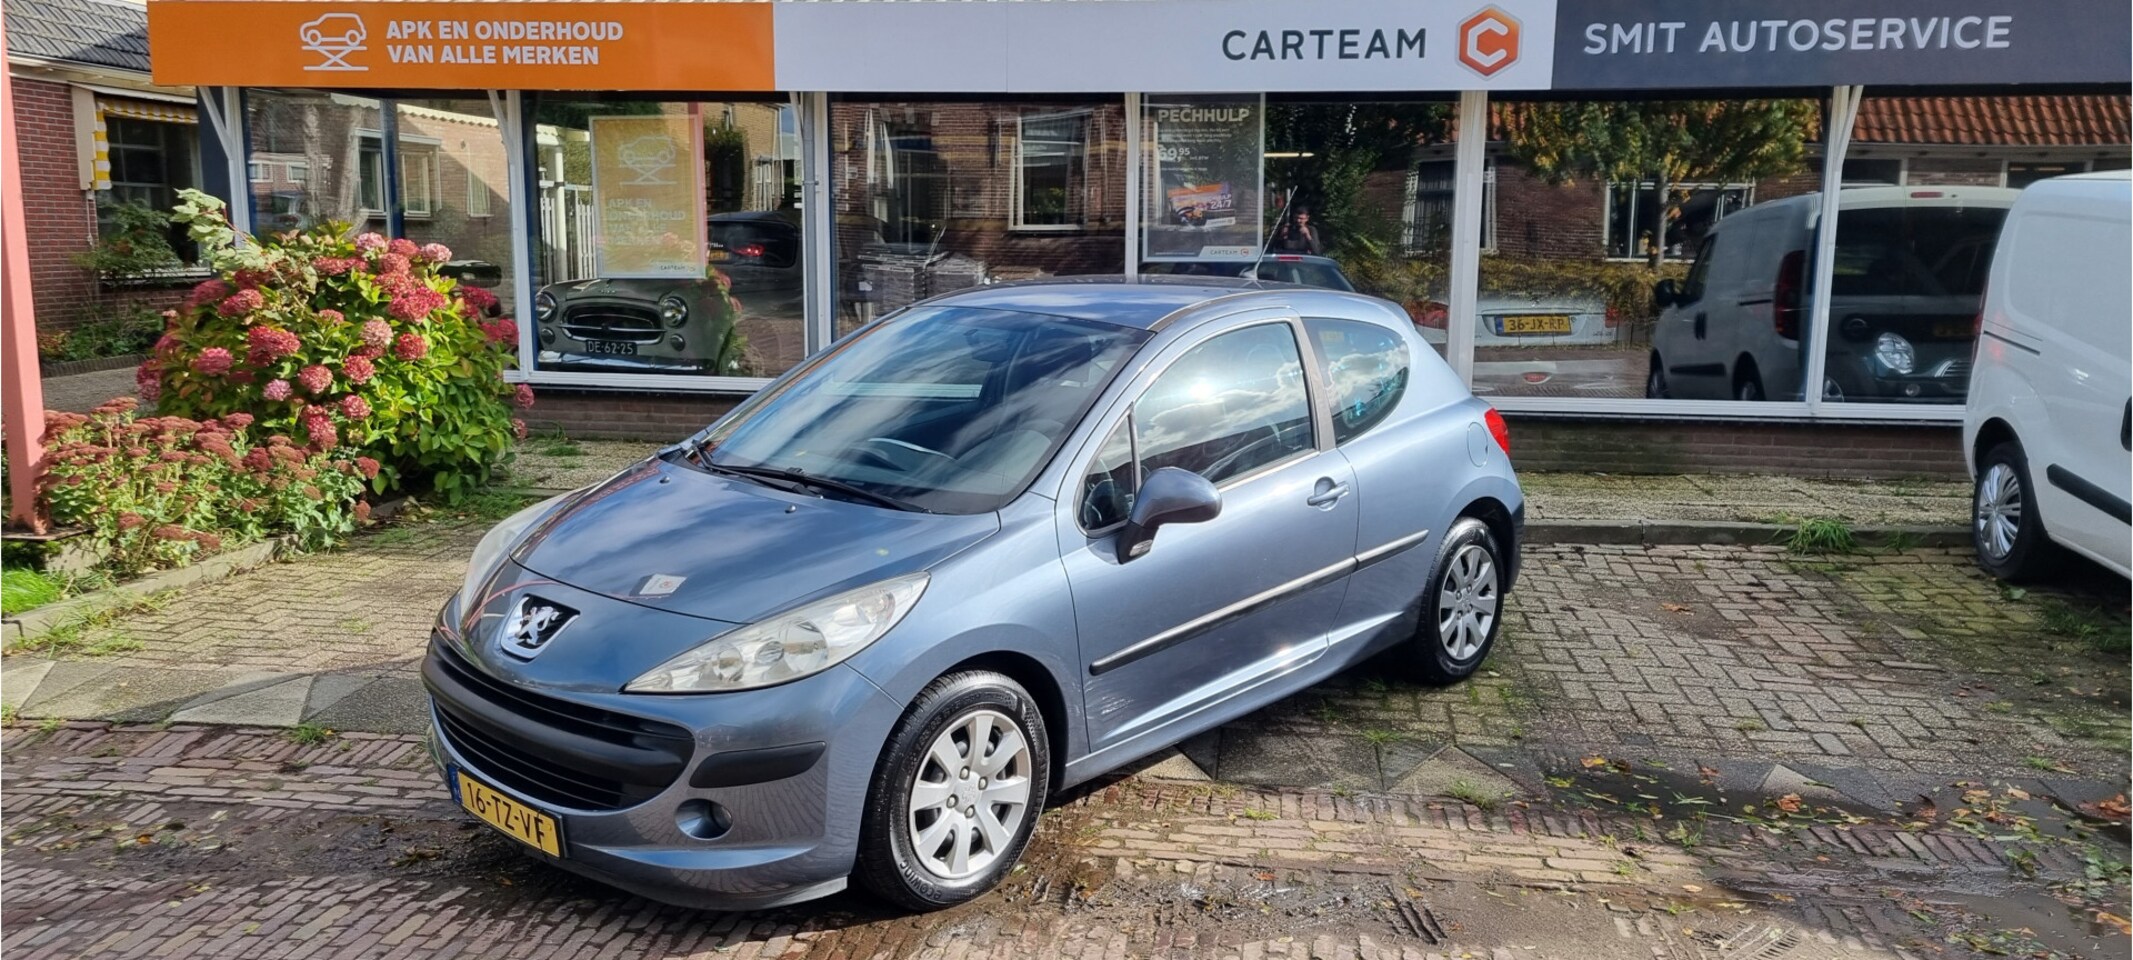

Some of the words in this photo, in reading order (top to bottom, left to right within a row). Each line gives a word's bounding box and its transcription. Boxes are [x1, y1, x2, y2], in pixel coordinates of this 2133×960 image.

[386, 21, 433, 39] APK
[439, 21, 469, 40] EN
[474, 21, 623, 41] ONDERHOUD
[1583, 22, 1686, 55] SMIT
[1699, 15, 2013, 53] AUTOSERVICE
[1221, 28, 1427, 61] CARTEAM
[386, 45, 434, 63] VAN
[440, 45, 497, 64] ALLE
[502, 45, 600, 65] MERKEN
[1157, 108, 1250, 123] PECHHULP
[1210, 199, 1232, 210] 24/7
[467, 782, 545, 844] 16-TZ-VF
